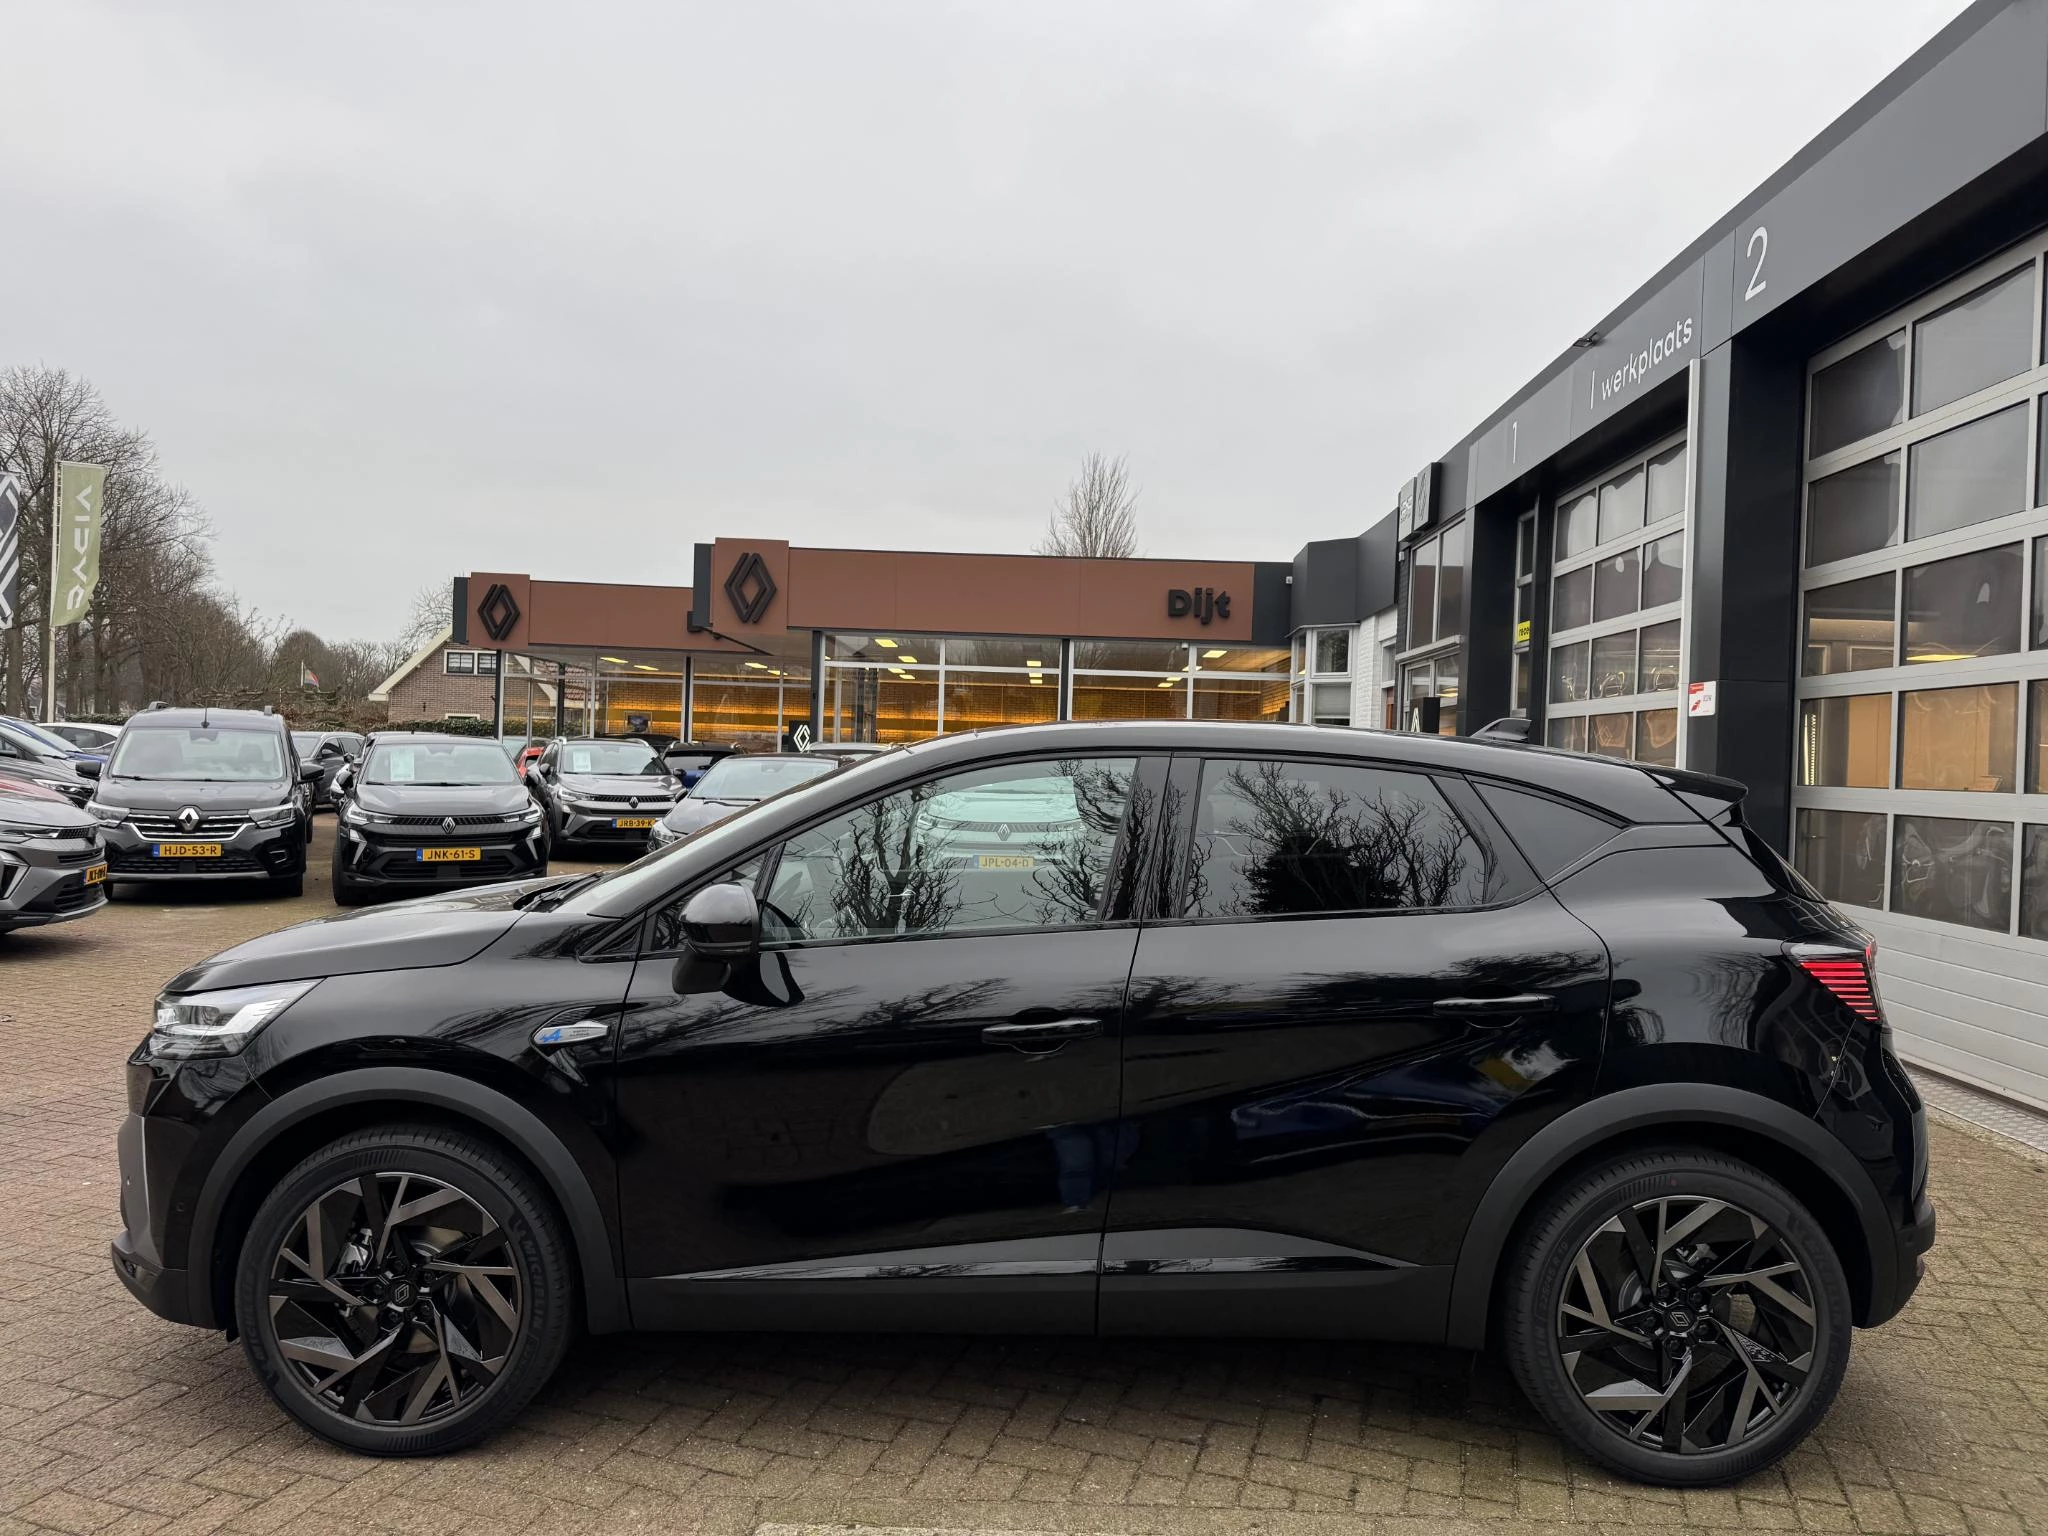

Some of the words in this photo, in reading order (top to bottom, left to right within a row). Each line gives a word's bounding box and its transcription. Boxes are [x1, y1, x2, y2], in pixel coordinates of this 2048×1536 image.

[1744, 226, 1768, 302] 2
[1511, 420, 1519, 465] 1
[1600, 316, 1694, 402] werkplaats
[66, 484, 93, 610] DACIA
[1167, 587, 1231, 625] Dijt
[164, 845, 217, 856] HJD-53-R
[428, 849, 476, 860] JNK-61-S
[519, 1238, 547, 1331] MICHELIN
